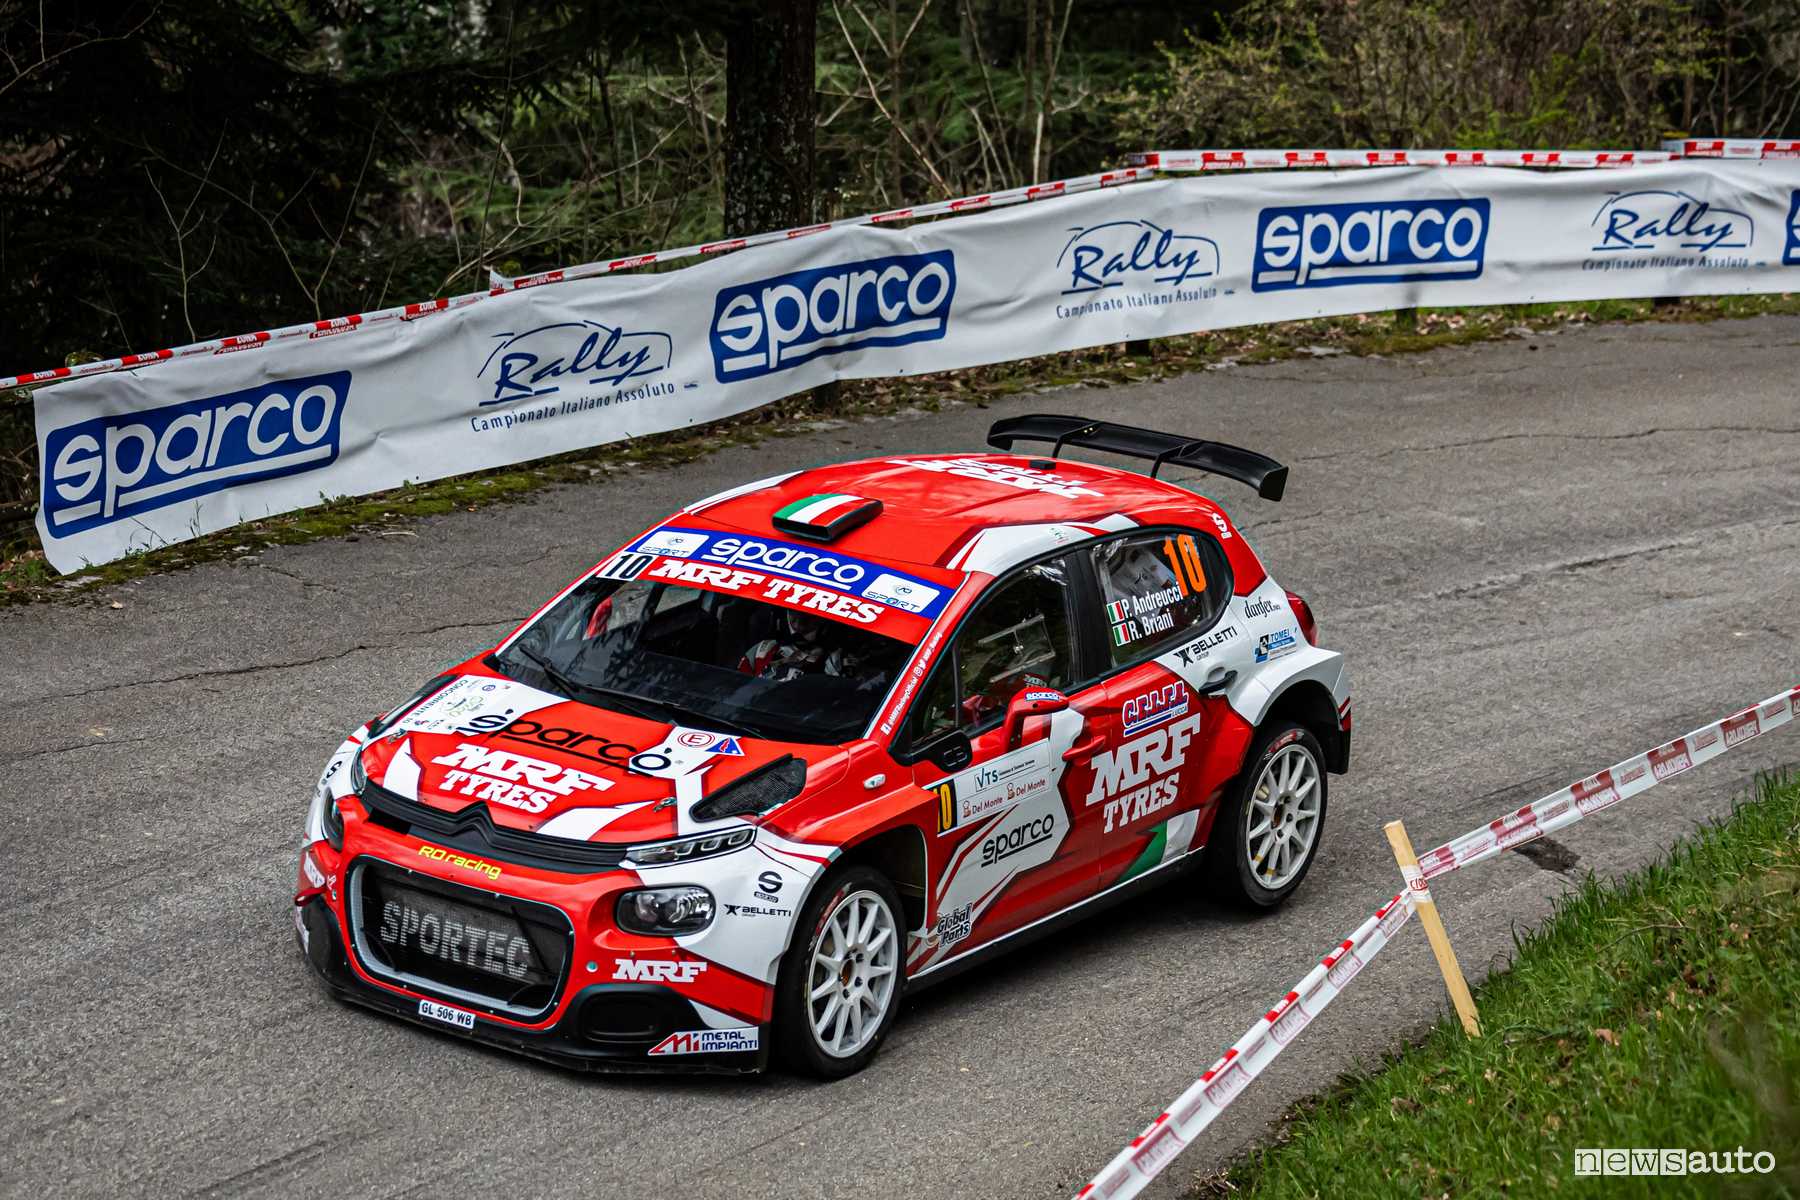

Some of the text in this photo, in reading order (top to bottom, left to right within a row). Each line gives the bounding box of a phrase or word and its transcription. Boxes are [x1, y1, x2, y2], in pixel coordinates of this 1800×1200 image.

[1263, 207, 1482, 285] sparco
[1603, 202, 1733, 252] Rally
[1072, 229, 1200, 288] Rally
[717, 261, 951, 369] sparco
[1056, 287, 1217, 320] Campionato Italiano Assoluto
[495, 327, 651, 398] Rally
[471, 382, 676, 433] Campionato Italiano Assoluto
[53, 385, 336, 518] sparco
[607, 554, 653, 579] 10
[710, 537, 865, 583] sparco
[1162, 534, 1208, 597] 10
[649, 559, 885, 623] MRF TYRES
[865, 590, 921, 612] SPORT
[1121, 582, 1183, 618] P. Andreucci
[1129, 610, 1174, 641] R. Briani
[1191, 626, 1238, 655] BELLETTI
[463, 710, 671, 774] sparco
[1086, 713, 1200, 806] MRF
[431, 743, 615, 796] MRF
[976, 768, 998, 788] VTS
[1016, 779, 1046, 797] Del Monte
[439, 770, 558, 813] TYRES
[971, 797, 1003, 815] Del Monte
[1104, 773, 1179, 833] TYRES
[982, 814, 1054, 864] sparco
[418, 845, 502, 880] RO racing
[742, 906, 791, 917] BELLETTI
[938, 903, 972, 933] Global
[379, 901, 530, 978] SPORTEC
[942, 924, 969, 945] Parts
[612, 958, 708, 983] MRF
[421, 1002, 472, 1026] GL 506 WB
[702, 1032, 745, 1041] METAL
[702, 1041, 757, 1051] IMPIANTI
